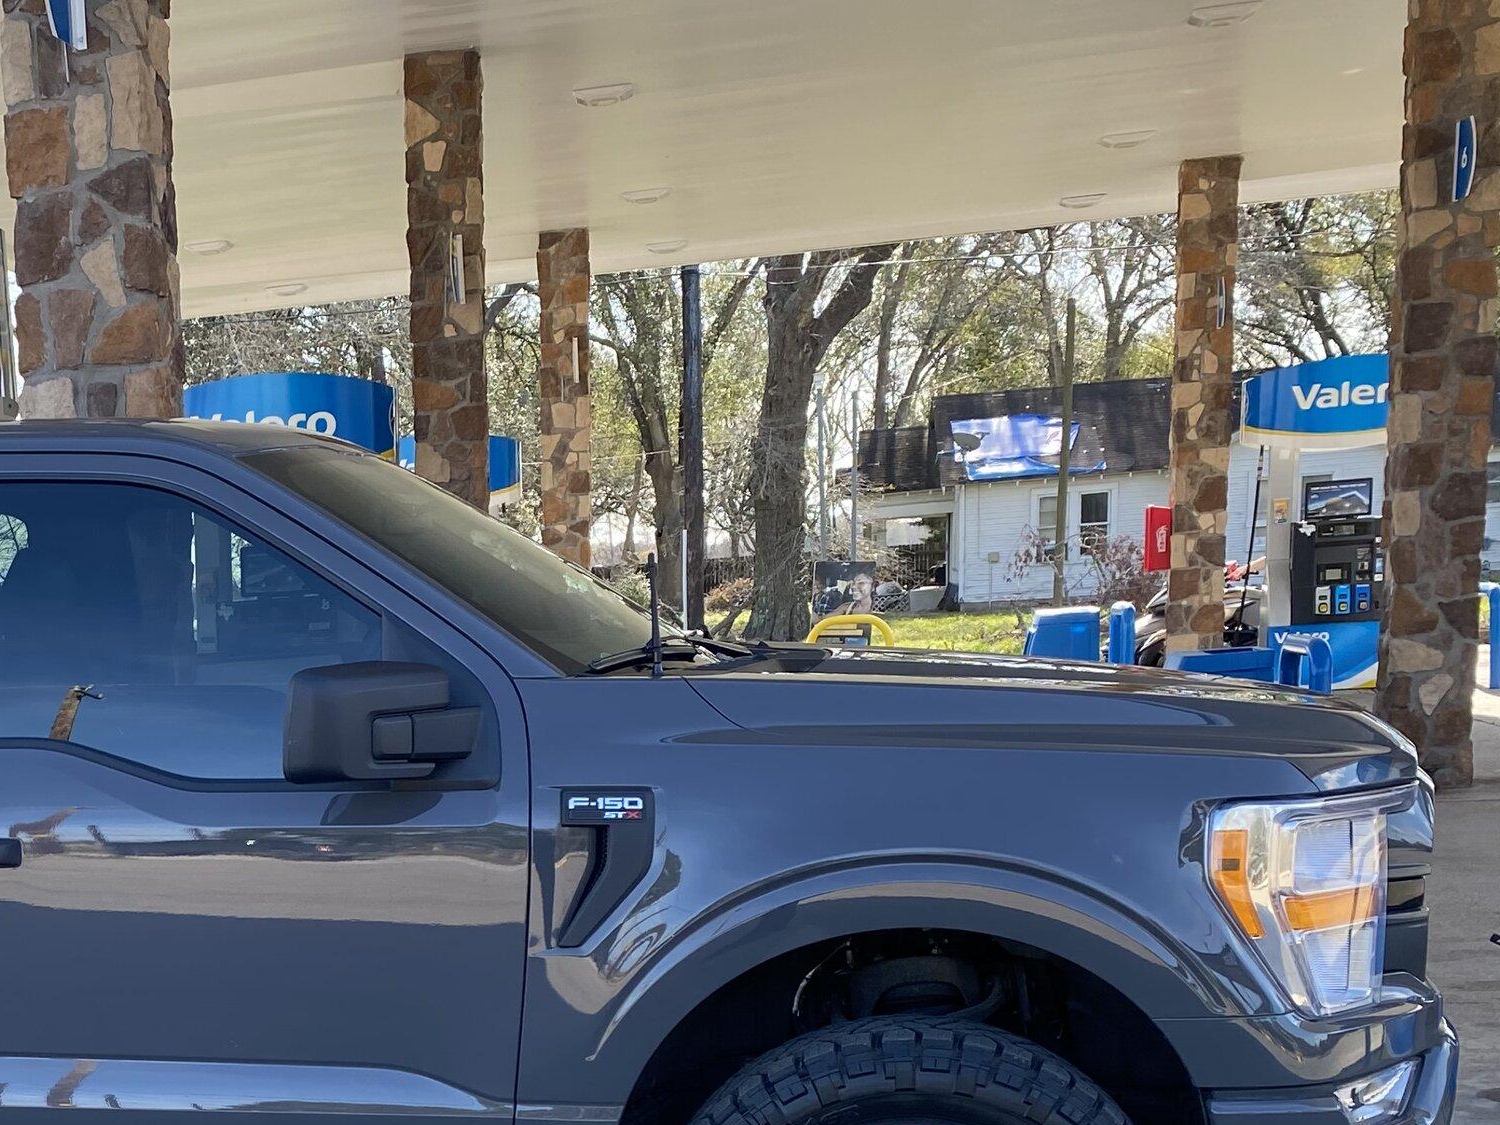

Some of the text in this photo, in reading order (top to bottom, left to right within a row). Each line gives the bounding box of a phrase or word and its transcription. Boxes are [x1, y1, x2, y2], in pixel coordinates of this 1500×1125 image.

[1291, 381, 1390, 410] Valer
[568, 797, 644, 810] F-150
[603, 811, 641, 819] STX
